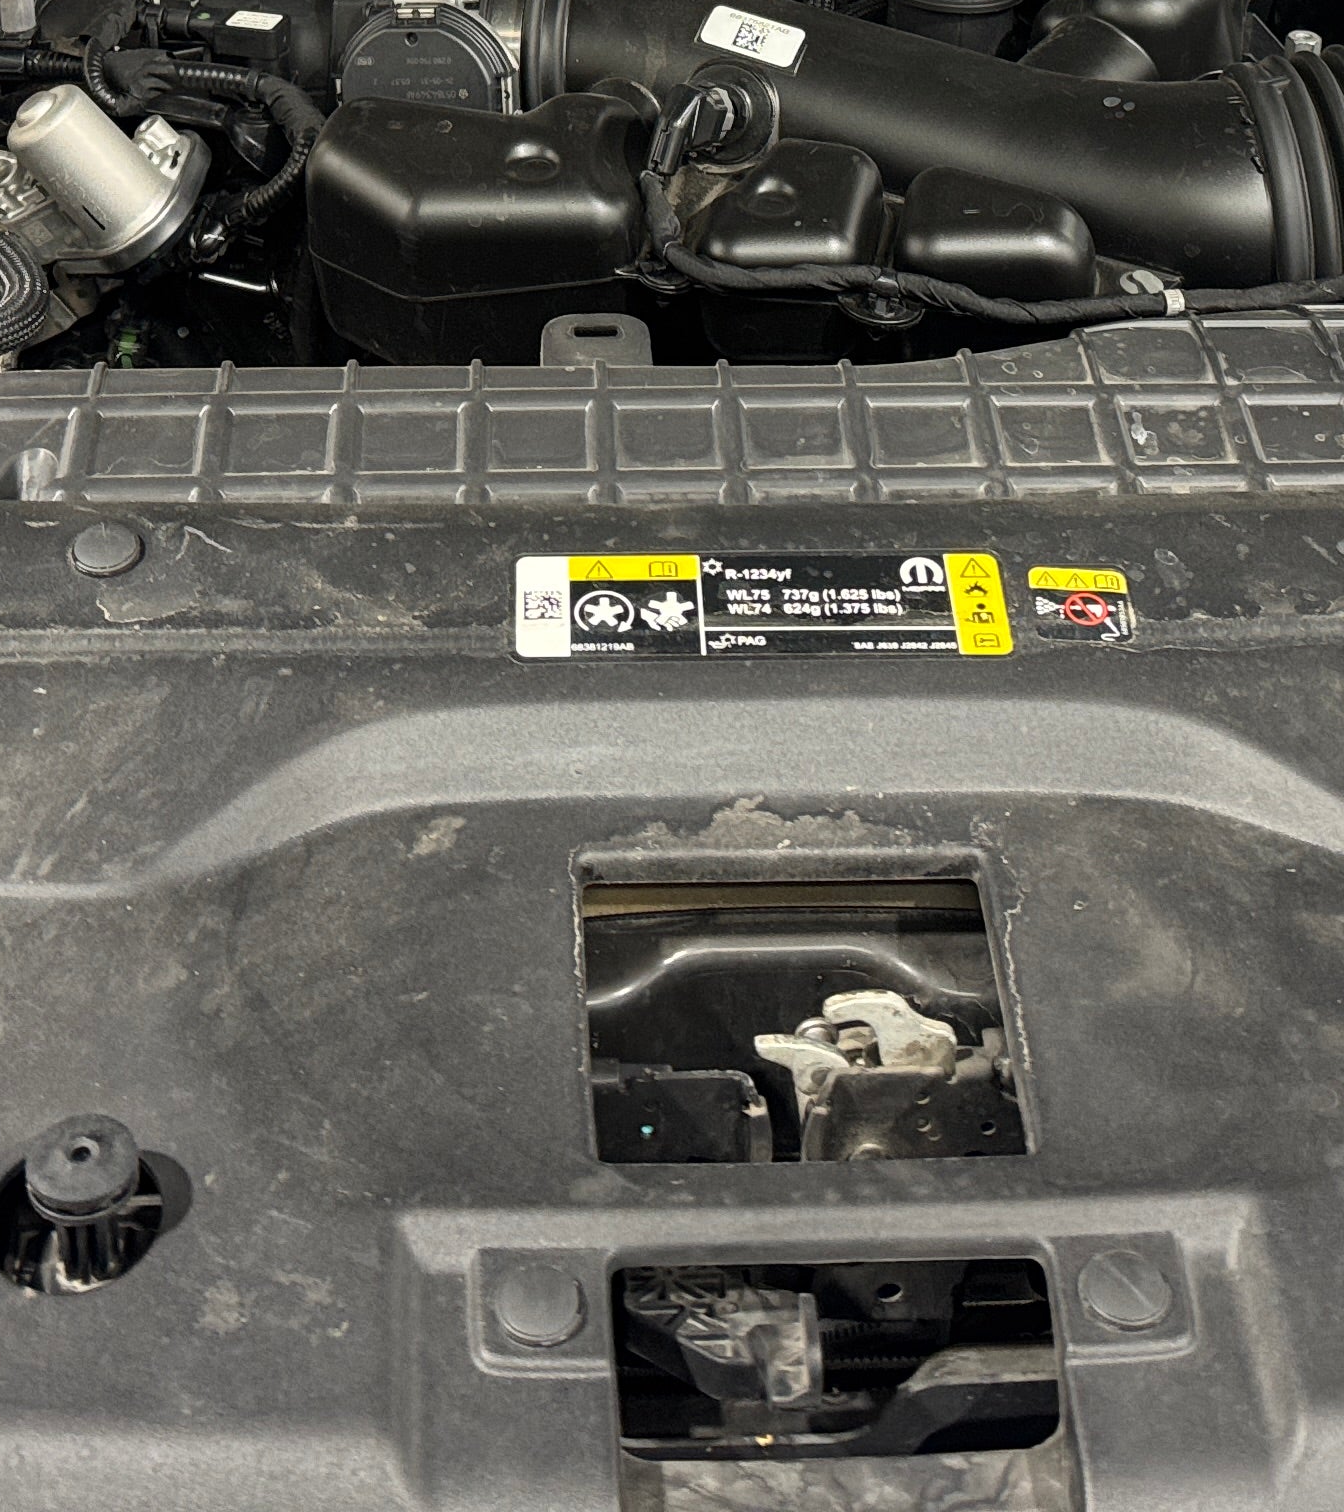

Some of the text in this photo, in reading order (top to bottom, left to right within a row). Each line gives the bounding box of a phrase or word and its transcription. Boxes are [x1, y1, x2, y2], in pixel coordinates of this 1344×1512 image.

[724, 568, 792, 582] R-1234yf
[726, 589, 771, 601] WL75
[781, 589, 820, 603] 737g
[822, 588, 869, 603] (1.625
[871, 588, 901, 603] lbs)
[727, 603, 904, 617] WL74 624g (1.375 lbs)
[737, 635, 767, 646] PAG
